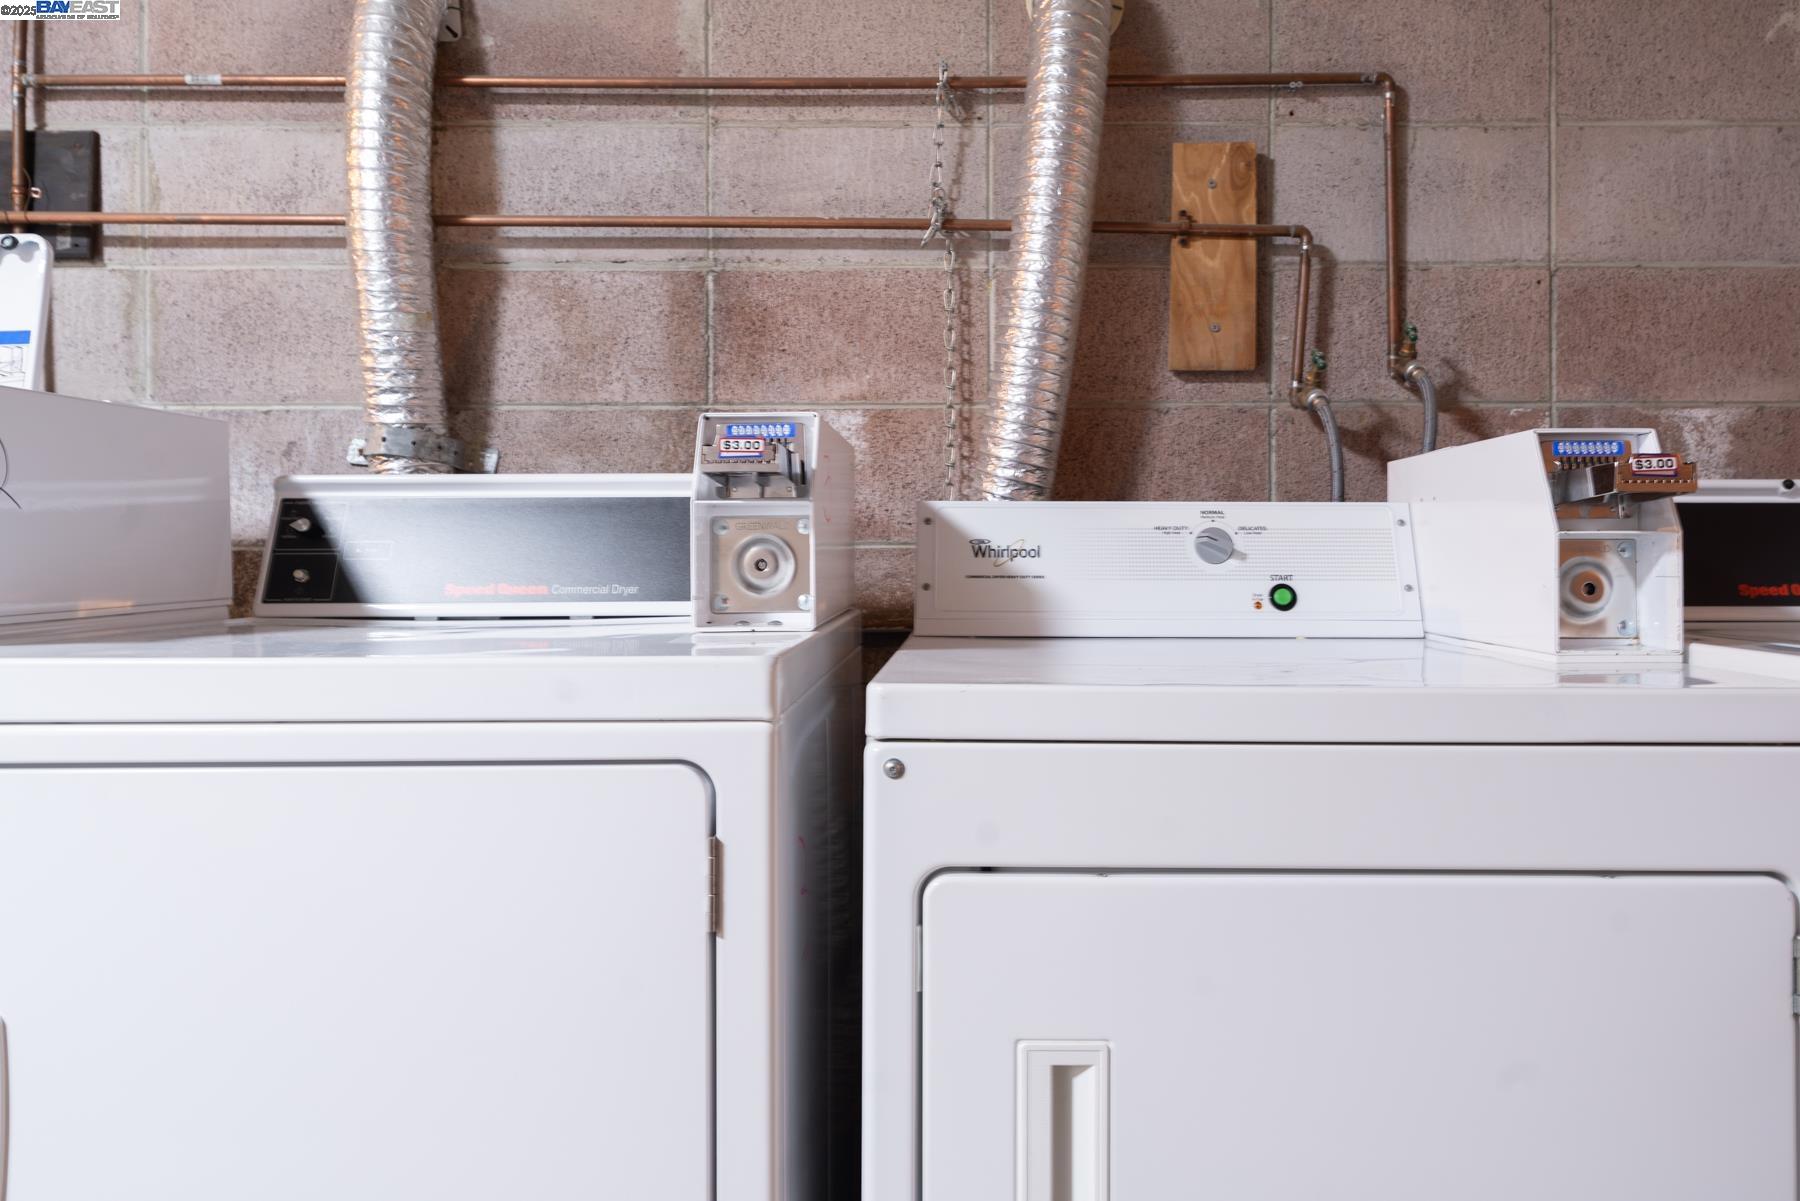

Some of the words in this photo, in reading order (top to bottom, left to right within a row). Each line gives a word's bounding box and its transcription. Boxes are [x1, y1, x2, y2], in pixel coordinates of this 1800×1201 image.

[723, 440, 761, 450] $3.00
[1635, 458, 1674, 469] $3.00
[971, 545, 1041, 562] Whirlpool
[551, 584, 610, 595] Commercial
[611, 584, 640, 597] Dryer
[1737, 583, 1790, 598] Speed
